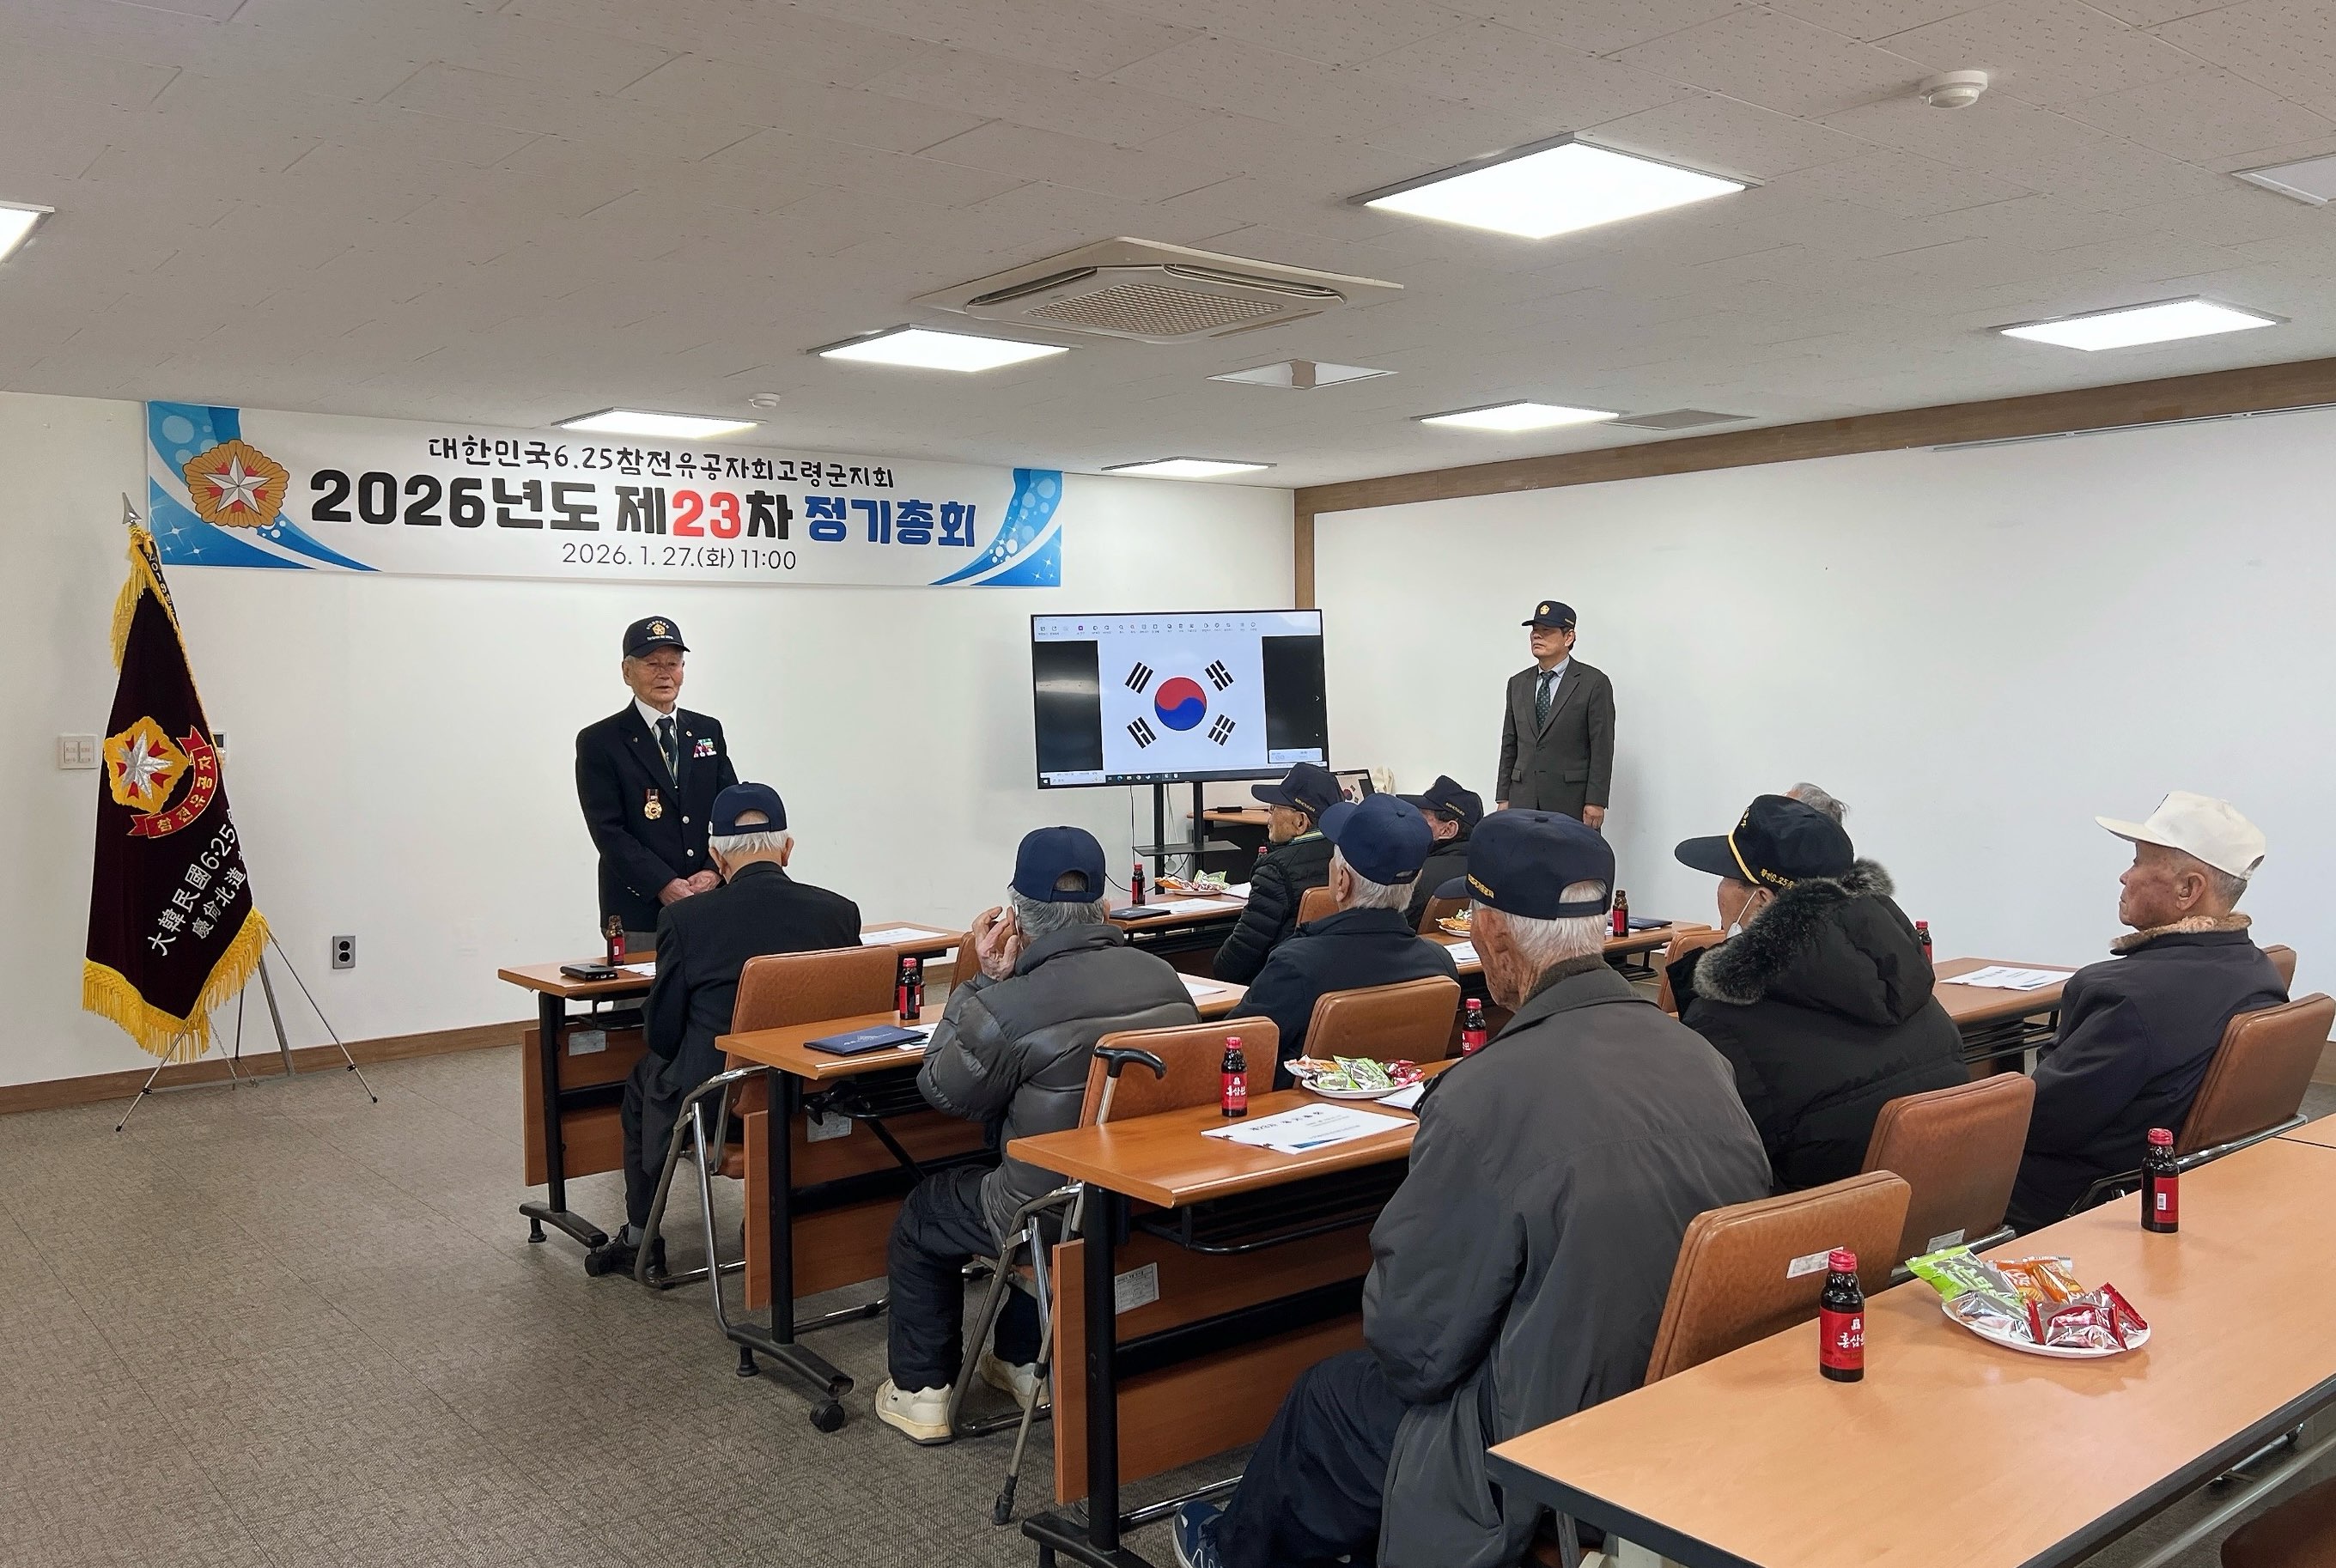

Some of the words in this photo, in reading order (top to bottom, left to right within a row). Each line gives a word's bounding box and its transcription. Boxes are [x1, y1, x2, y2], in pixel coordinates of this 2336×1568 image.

[429, 435, 894, 488] 대한민국6.25참전유공자회고령군지회
[310, 469, 600, 532] 2026년도
[614, 485, 794, 540] 제23차
[804, 495, 976, 547] 정기총회
[740, 549, 796, 570] 11:00
